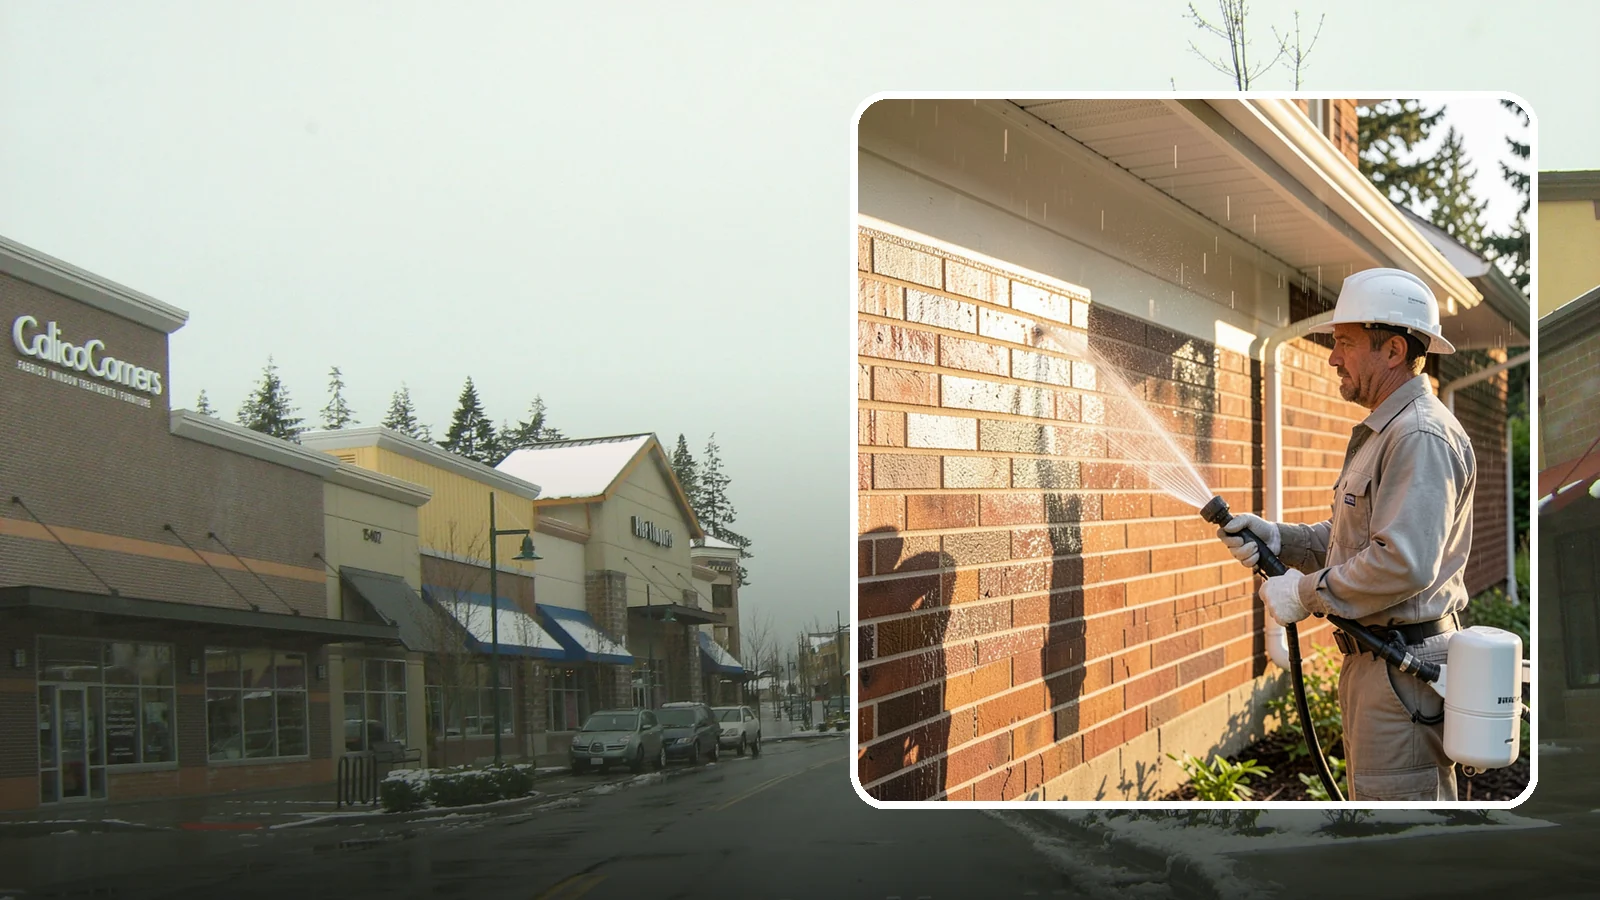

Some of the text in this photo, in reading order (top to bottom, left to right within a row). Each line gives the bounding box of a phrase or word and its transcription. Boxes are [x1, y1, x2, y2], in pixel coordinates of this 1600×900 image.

[17, 360, 47, 377] FABRICS
[51, 370, 78, 387] WINDOW
[78, 378, 117, 399] TREATMENTS
